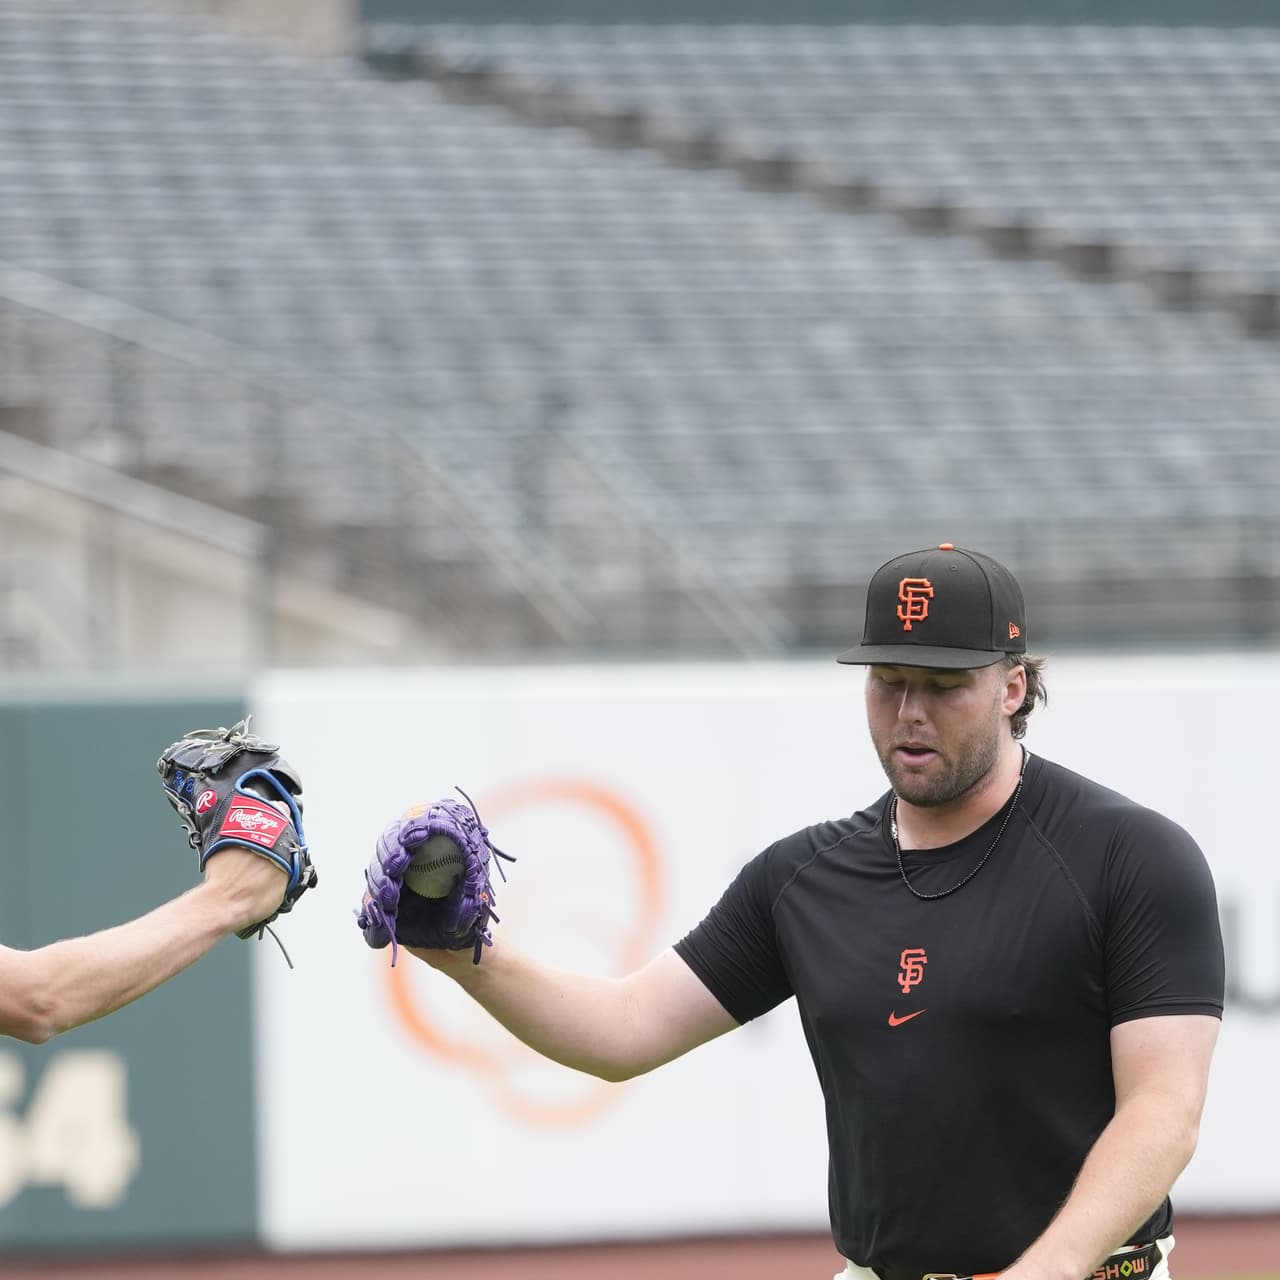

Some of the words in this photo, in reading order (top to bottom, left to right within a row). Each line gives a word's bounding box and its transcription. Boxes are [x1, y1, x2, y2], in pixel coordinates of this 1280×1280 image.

[897, 578, 934, 631] SF
[229, 809, 279, 830] Rawlings
[897, 948, 928, 993] SF
